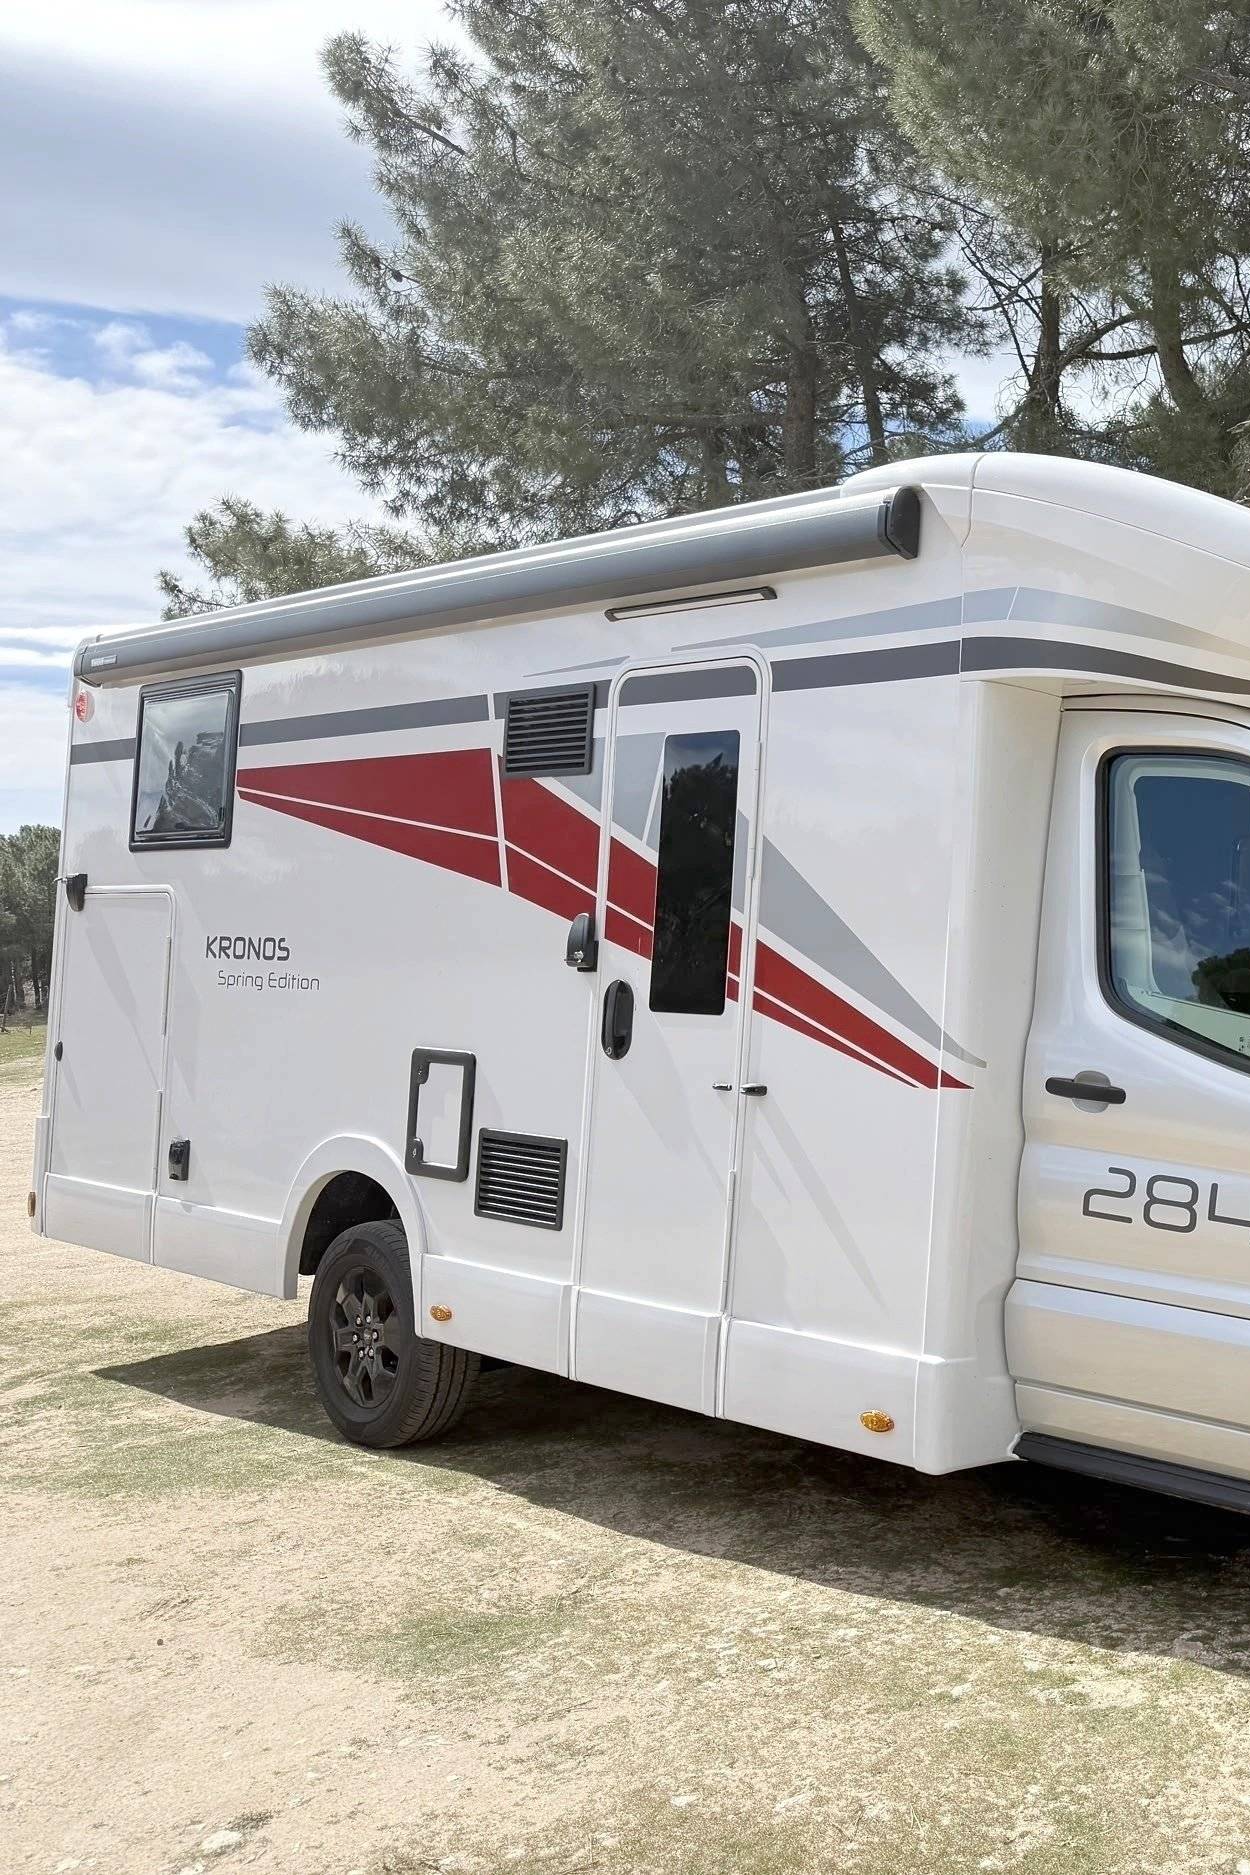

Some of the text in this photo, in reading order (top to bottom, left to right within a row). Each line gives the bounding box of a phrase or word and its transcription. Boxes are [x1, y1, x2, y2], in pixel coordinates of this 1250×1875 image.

[205, 935, 291, 961] KRONOS
[217, 970, 320, 991] Spring Edition
